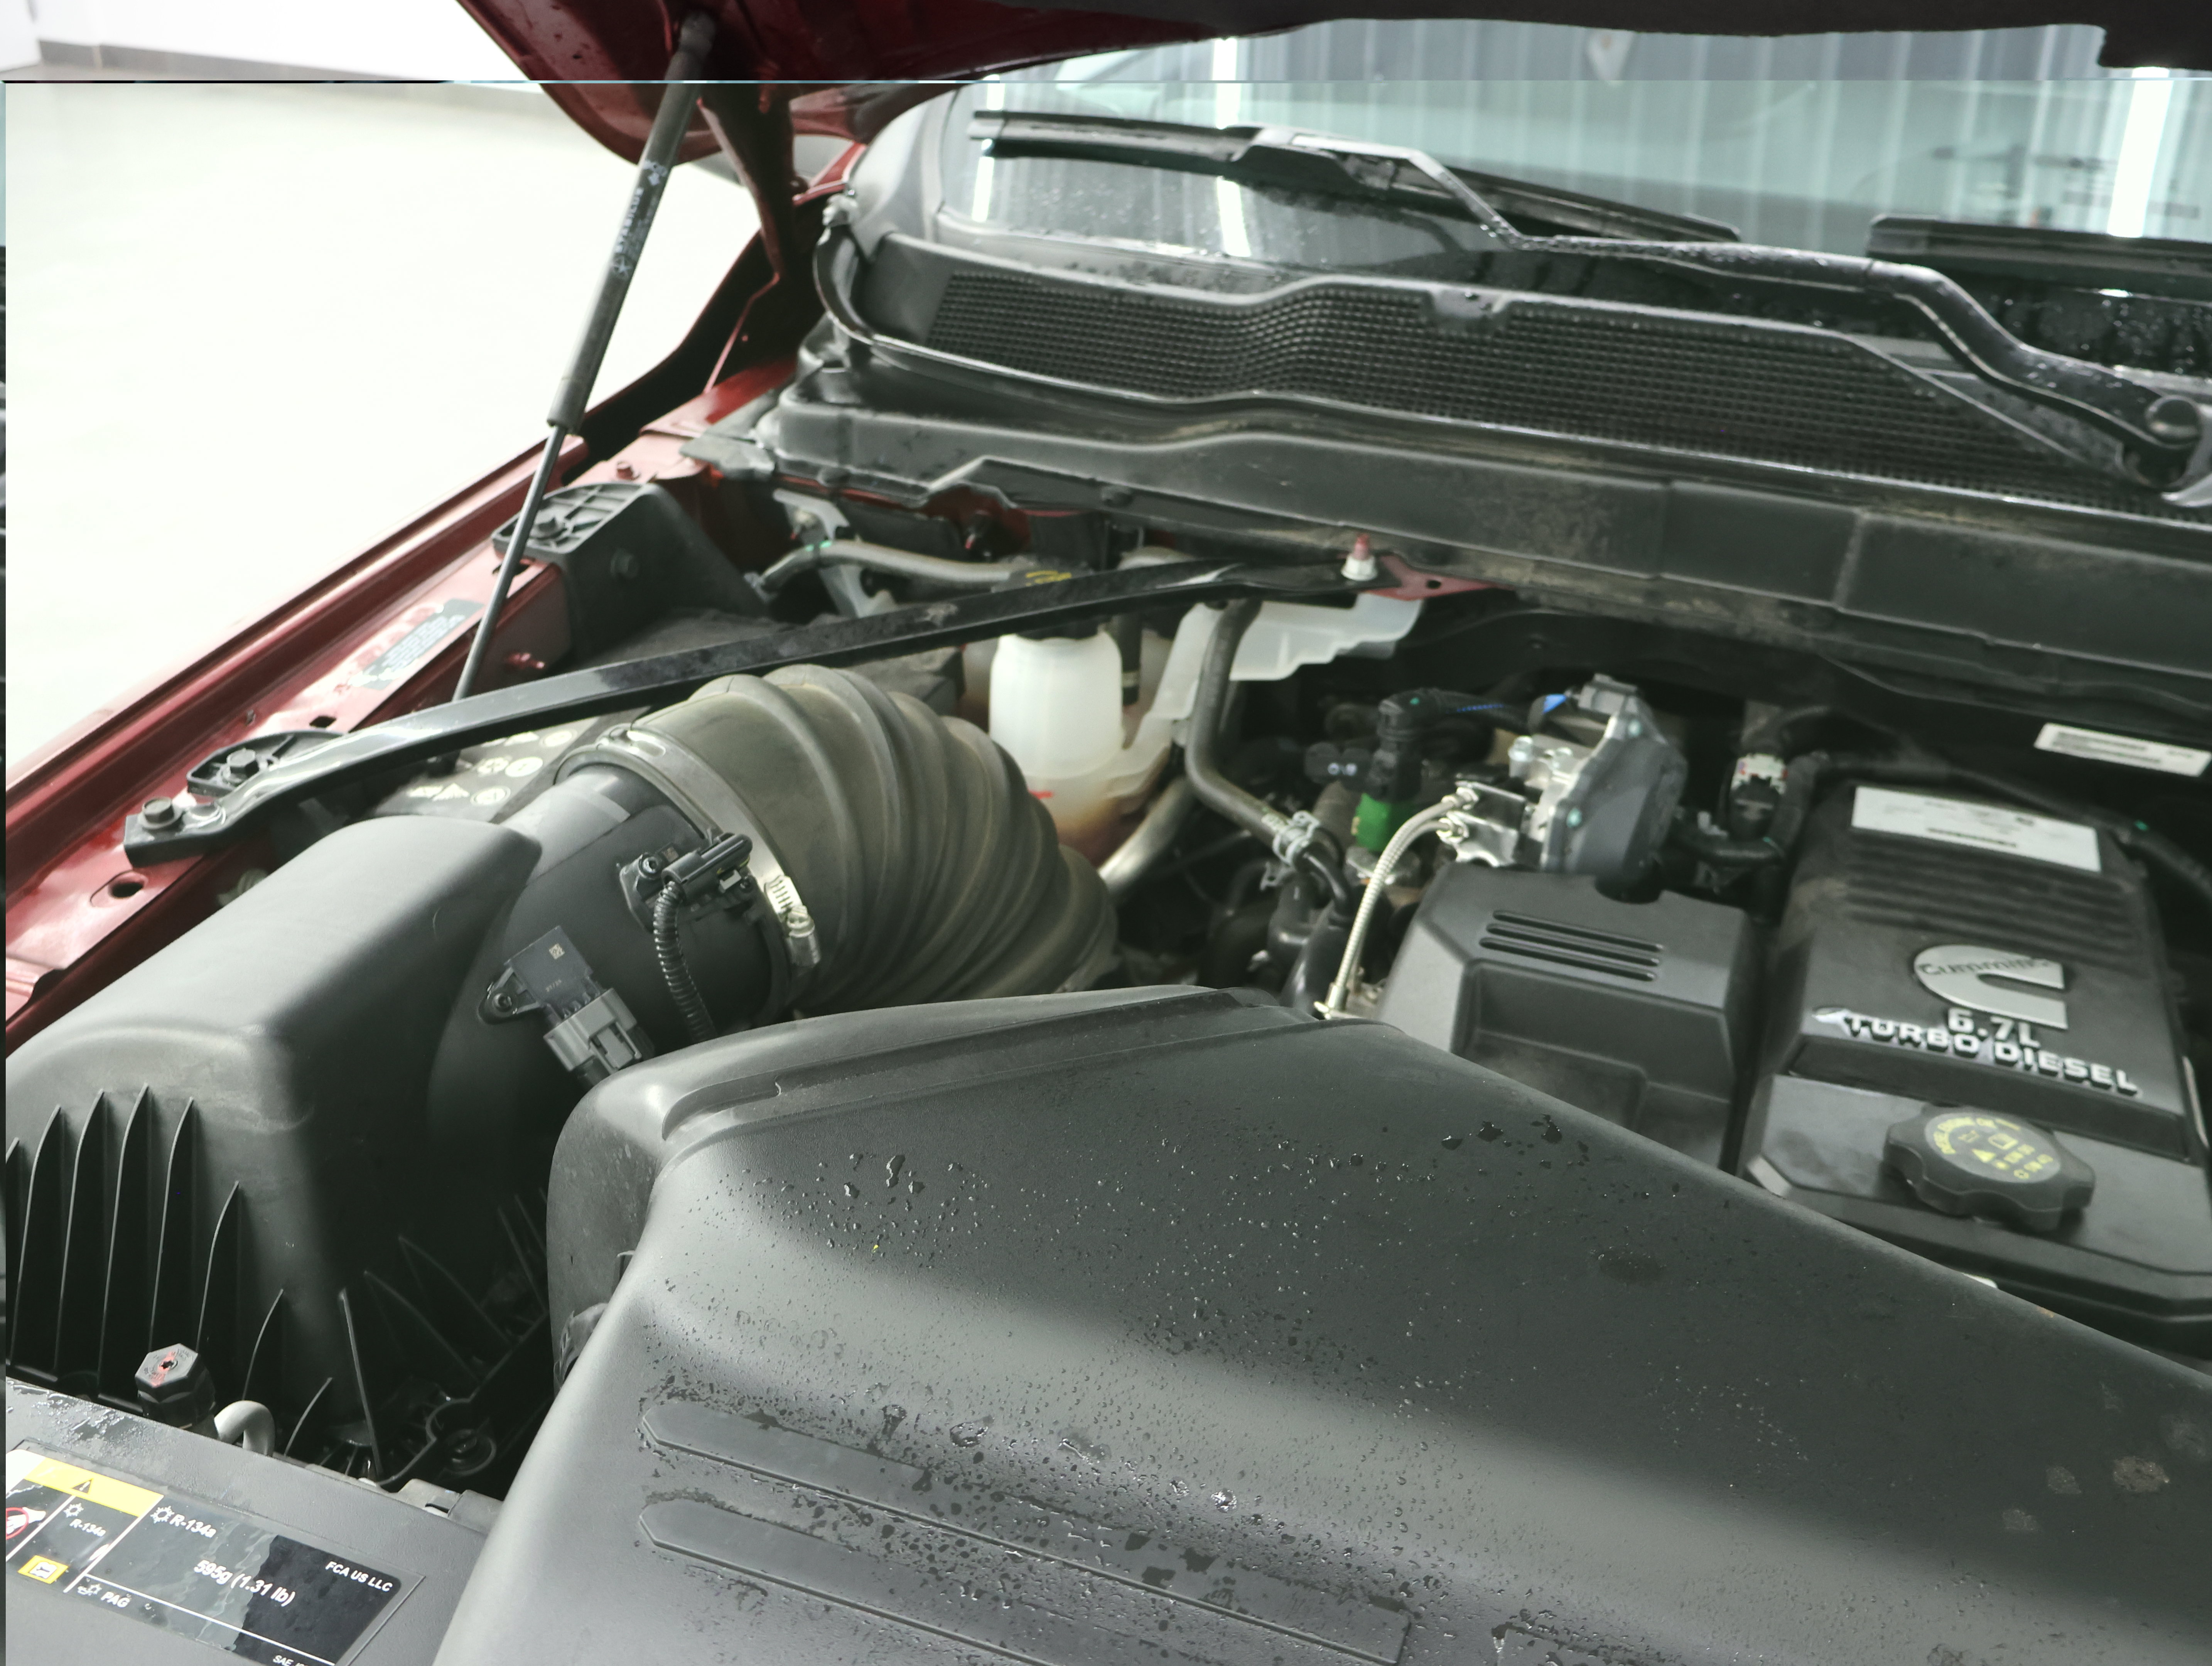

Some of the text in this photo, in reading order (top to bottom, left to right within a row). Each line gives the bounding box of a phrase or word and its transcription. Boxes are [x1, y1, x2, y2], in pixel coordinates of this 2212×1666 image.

[1948, 1007, 2041, 1049] 6.7L
[1850, 1013, 2139, 1094] TURBO DIESEL
[70, 1518, 106, 1537] R-134a
[170, 1514, 216, 1538] R-134a
[194, 1560, 296, 1607] 595g (1.31 lb)
[325, 1561, 393, 1592] FCA US LLC
[101, 1591, 130, 1608] PAG
